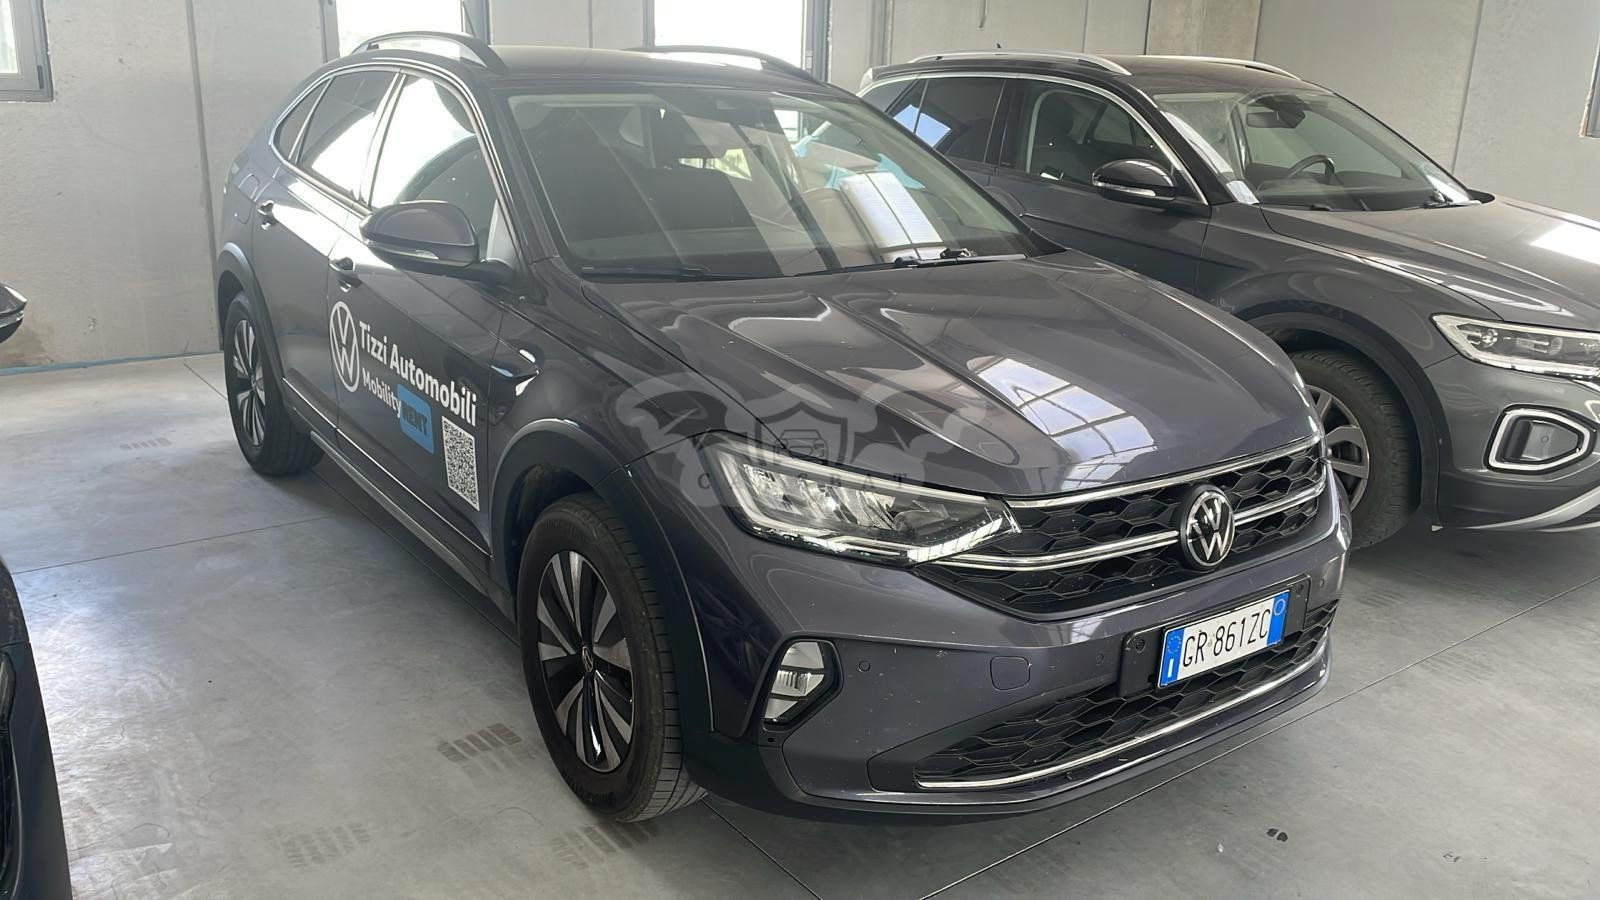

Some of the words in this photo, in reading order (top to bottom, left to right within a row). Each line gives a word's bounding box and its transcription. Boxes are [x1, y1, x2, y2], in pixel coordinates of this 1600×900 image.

[359, 320, 388, 365] Tizzi
[389, 344, 477, 427] Automobili
[362, 368, 402, 418] Mobility
[1182, 630, 1208, 668] GR
[1213, 609, 1271, 657] 861ZC
